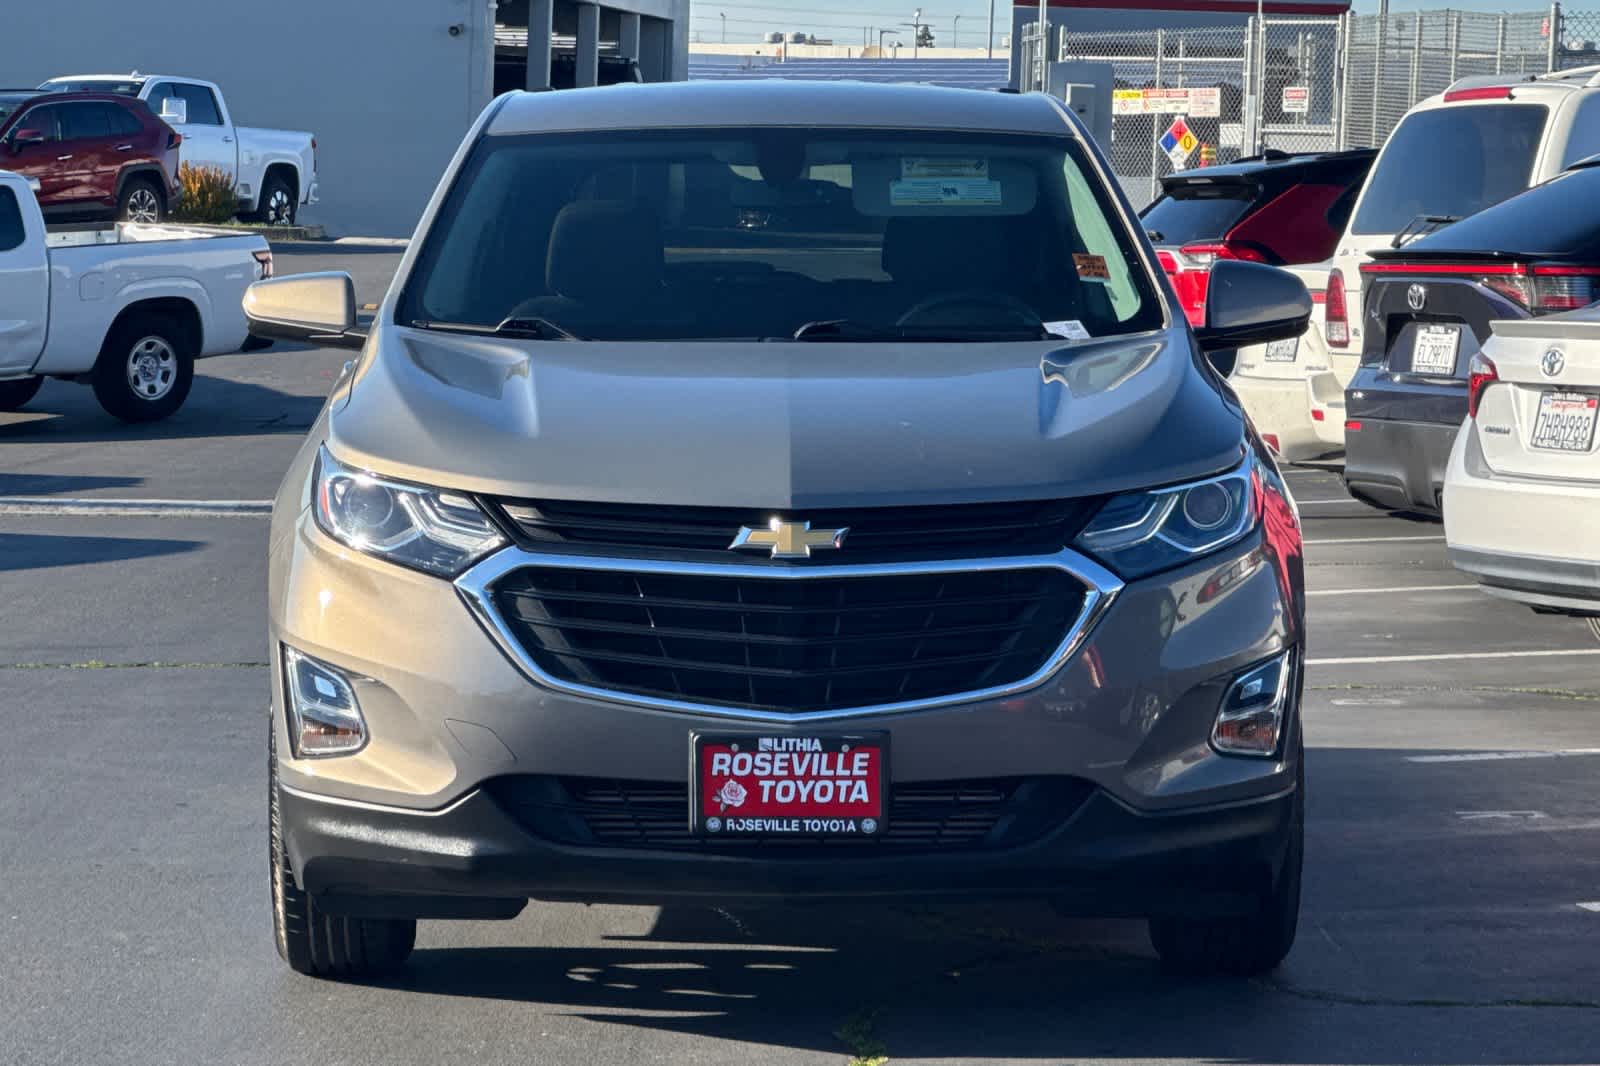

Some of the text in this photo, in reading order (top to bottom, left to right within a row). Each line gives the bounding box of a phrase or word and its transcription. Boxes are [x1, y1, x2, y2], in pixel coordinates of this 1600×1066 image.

[1535, 412, 1591, 441] 7HBH988
[774, 738, 823, 752] LITHIA
[711, 752, 870, 777] ROSEVILLE
[759, 779, 870, 804] TOYOTA
[726, 818, 857, 832] ROSEVILLE TOYOTA
